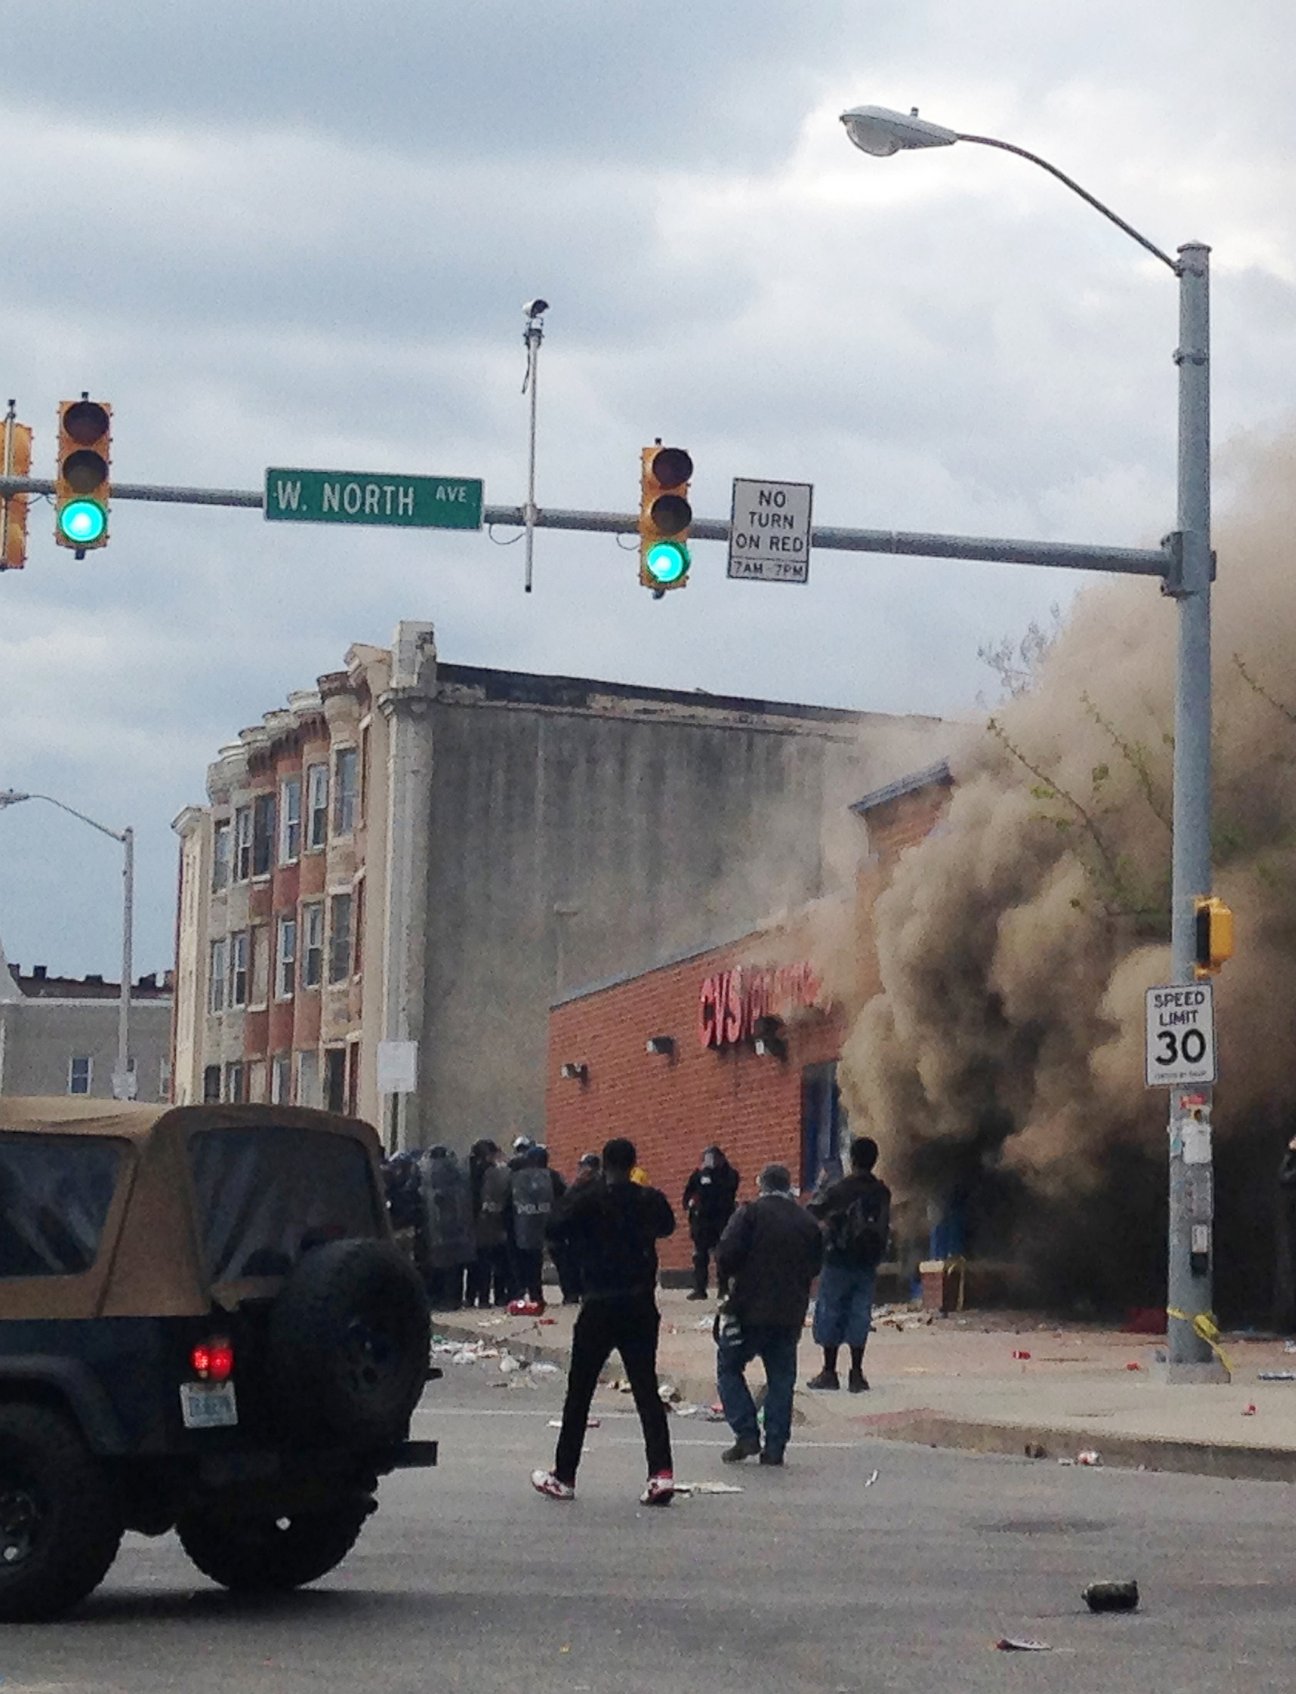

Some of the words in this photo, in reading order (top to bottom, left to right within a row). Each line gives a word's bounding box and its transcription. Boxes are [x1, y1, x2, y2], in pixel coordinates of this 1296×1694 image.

[276, 479, 307, 512] W.
[322, 482, 415, 517] NORTH
[435, 484, 468, 503] AVE
[758, 489, 786, 508] NO
[748, 511, 794, 530] TURN
[735, 532, 760, 550] ON
[768, 535, 804, 553] RED
[699, 967, 742, 1047] CVS
[1154, 991, 1205, 1008] SPEED
[1159, 1009, 1199, 1027] LIMIT
[1155, 1028, 1206, 1065] 30
